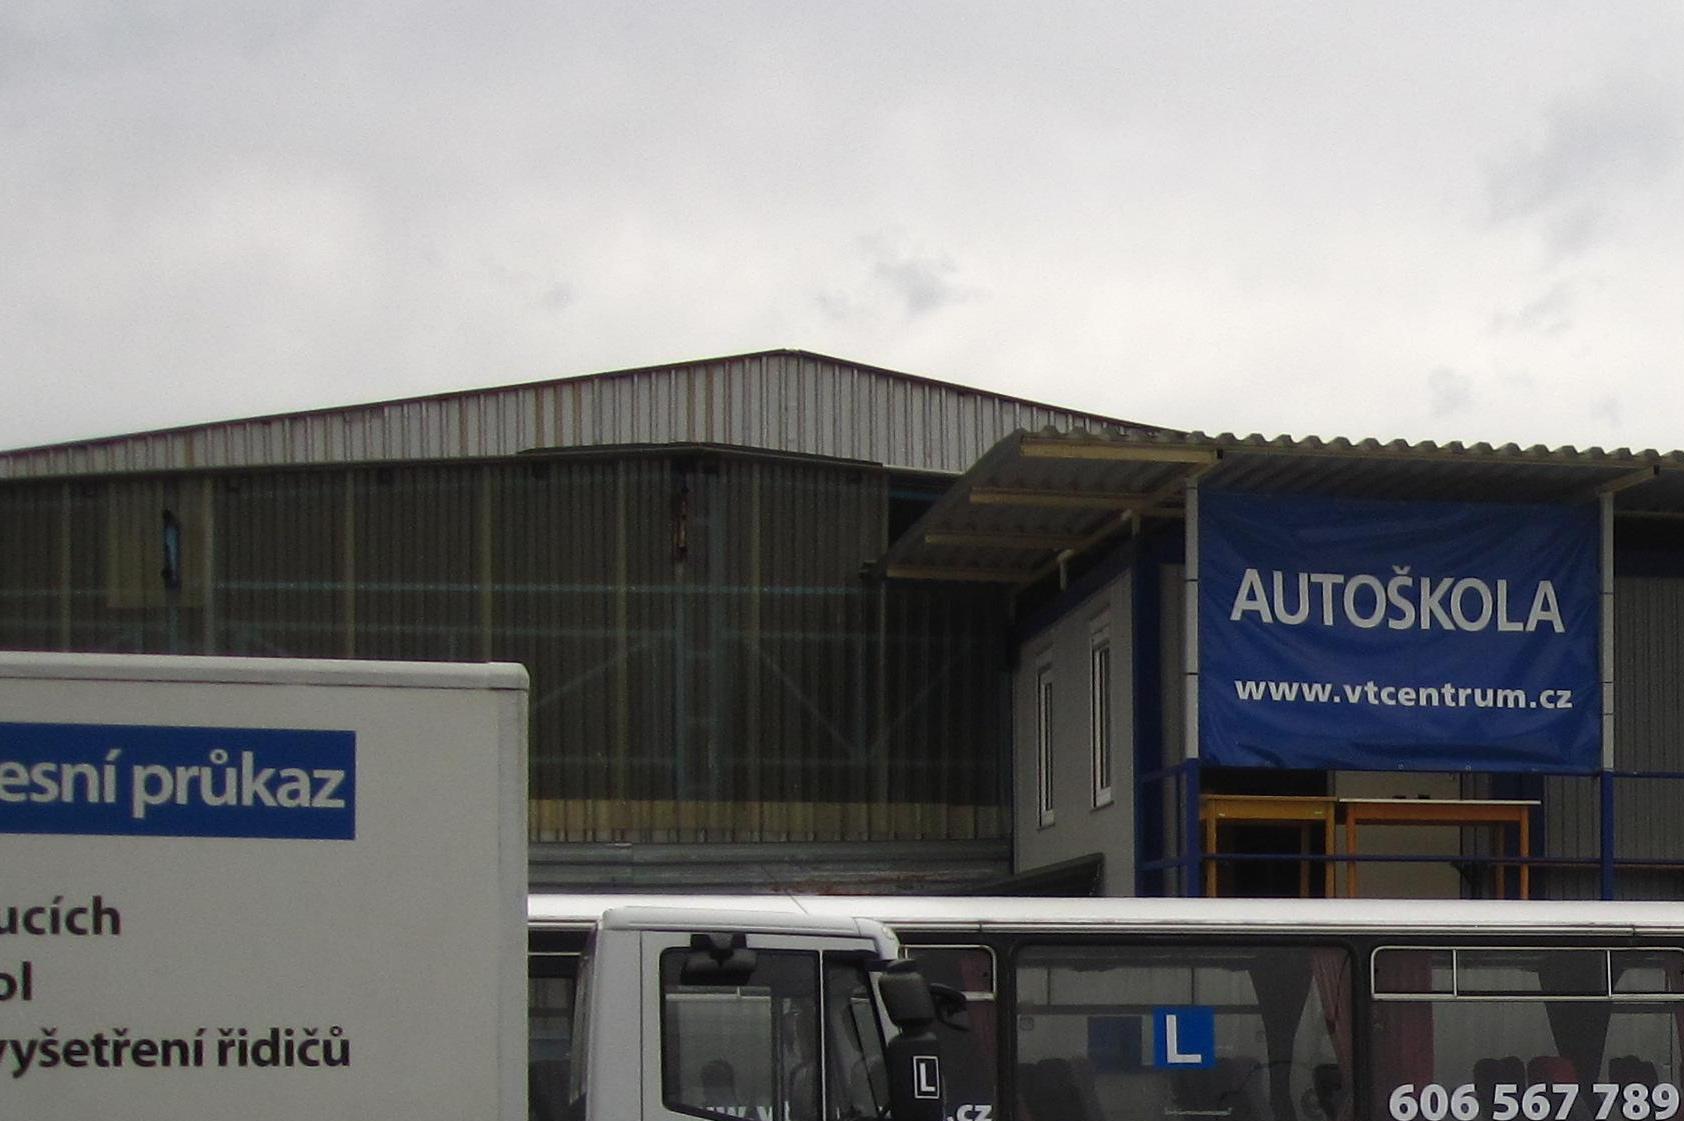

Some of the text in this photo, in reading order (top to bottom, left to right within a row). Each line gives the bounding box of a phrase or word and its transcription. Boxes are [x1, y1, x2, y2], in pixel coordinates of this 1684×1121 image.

[1230, 565, 1566, 633] AUTOŠKOLA
[1234, 679, 1573, 709] www.vtcentrum.cz
[132, 749, 346, 819] průkaz
[217, 1026, 351, 1068] řidičů
[1165, 1014, 1202, 1064] L
[918, 1062, 936, 1092] L
[1388, 1083, 1680, 1121] 606 567 789
